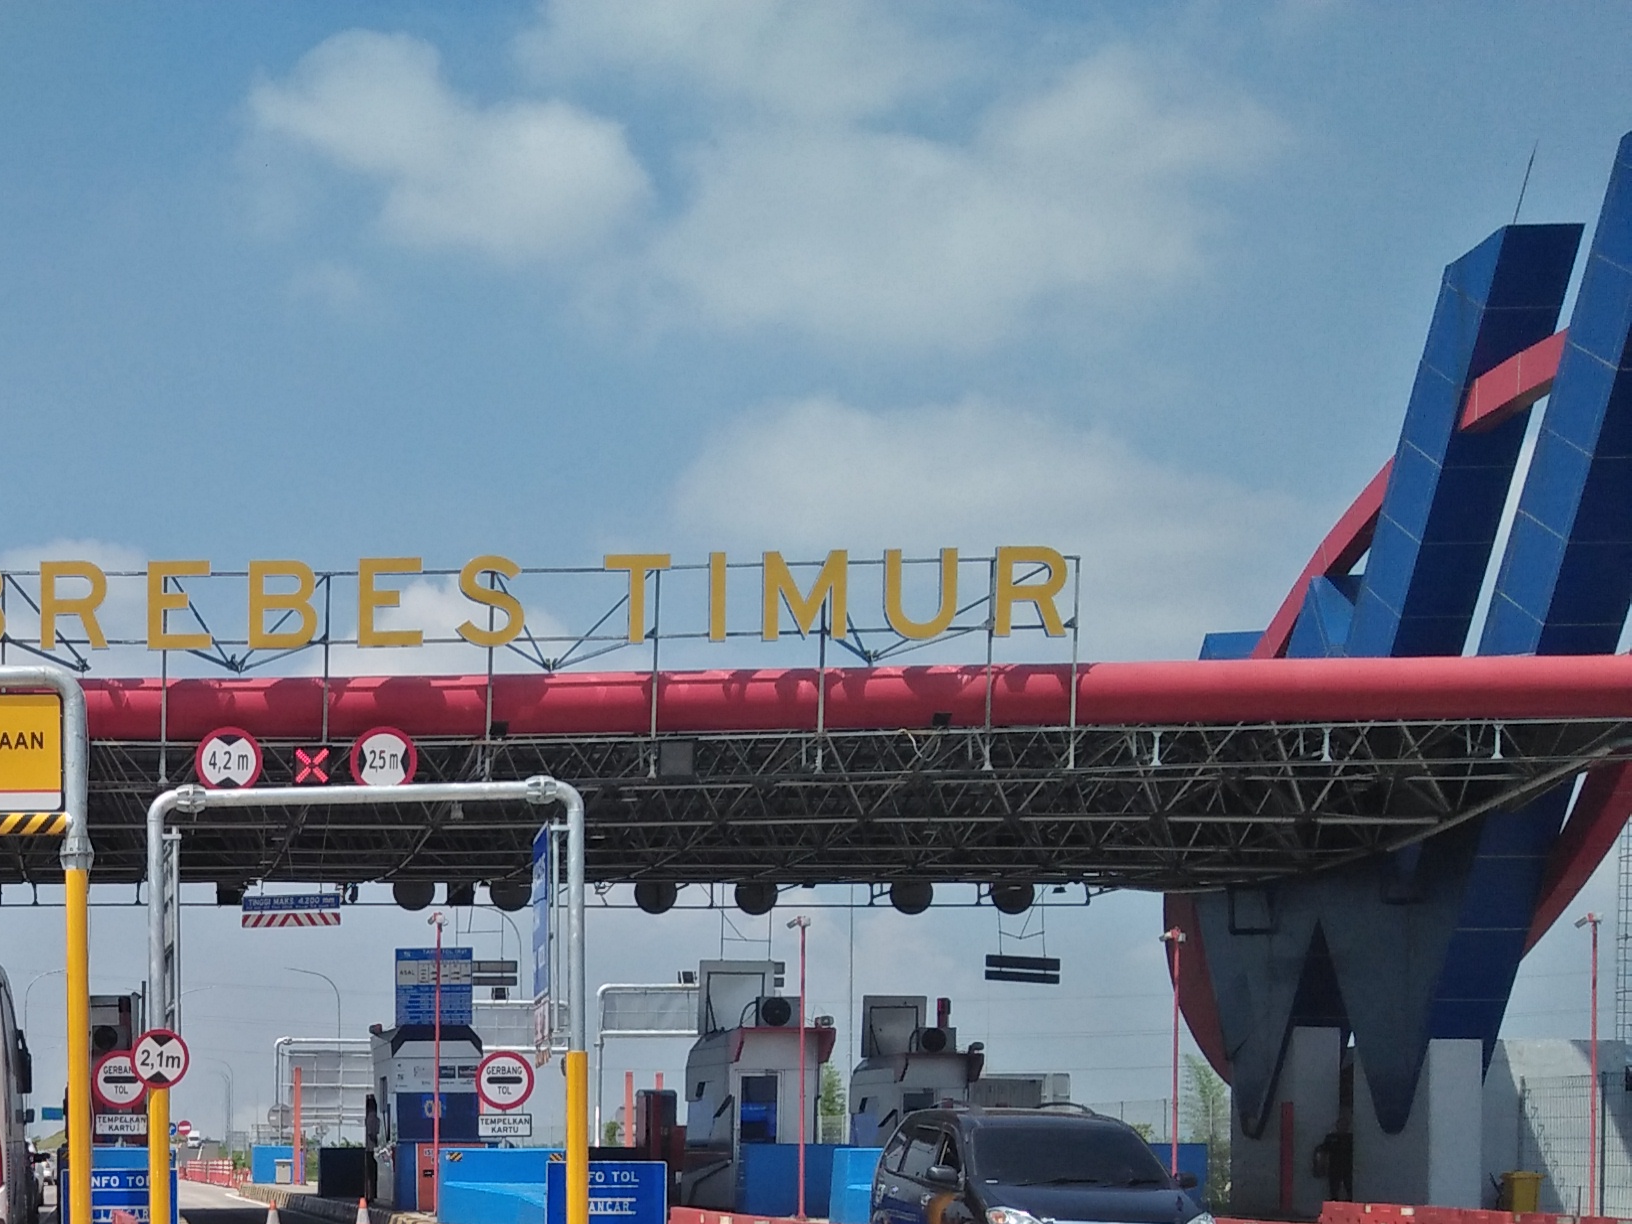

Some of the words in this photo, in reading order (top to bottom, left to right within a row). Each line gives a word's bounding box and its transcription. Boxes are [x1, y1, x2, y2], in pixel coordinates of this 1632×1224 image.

[606, 547, 1066, 642] TIMUR
[208, 750, 232, 774] 4,2
[237, 755, 249, 771] m
[389, 755, 399, 770] m
[140, 1049, 181, 1070] 2,1m
[103, 1065, 133, 1074] GERBAN
[486, 1065, 523, 1075] GERBANG
[114, 1085, 129, 1095] TOL
[497, 1086, 512, 1095] TOL
[97, 1115, 147, 1125] TEMPELKAN
[480, 1117, 530, 1126] TEMPELKAN
[108, 1124, 136, 1132] KARTU
[92, 1175, 120, 1187] NFO
[611, 1171, 640, 1182] TOL
[589, 1201, 630, 1212] ANCAR
